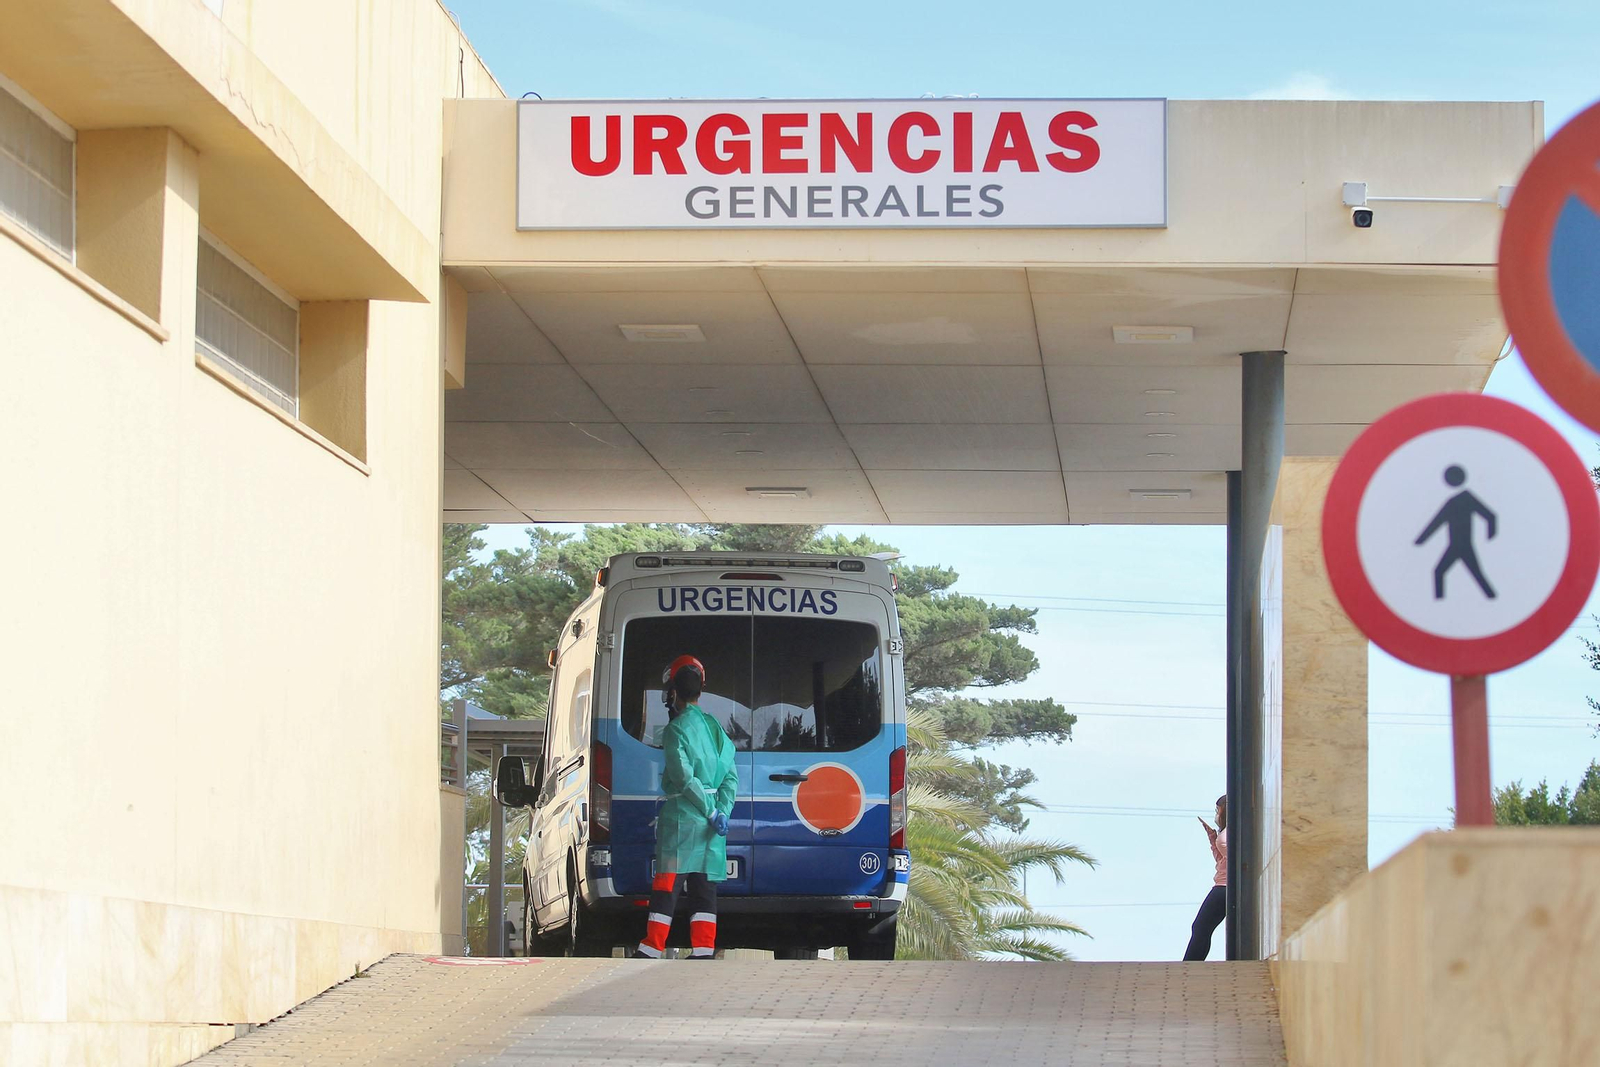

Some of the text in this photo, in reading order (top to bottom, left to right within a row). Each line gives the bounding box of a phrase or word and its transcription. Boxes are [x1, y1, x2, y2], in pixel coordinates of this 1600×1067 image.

[571, 111, 1100, 177] URGENCIAS
[684, 184, 1004, 220] GENERALES
[658, 587, 838, 615] URGENCIAS
[862, 857, 877, 869] 301
